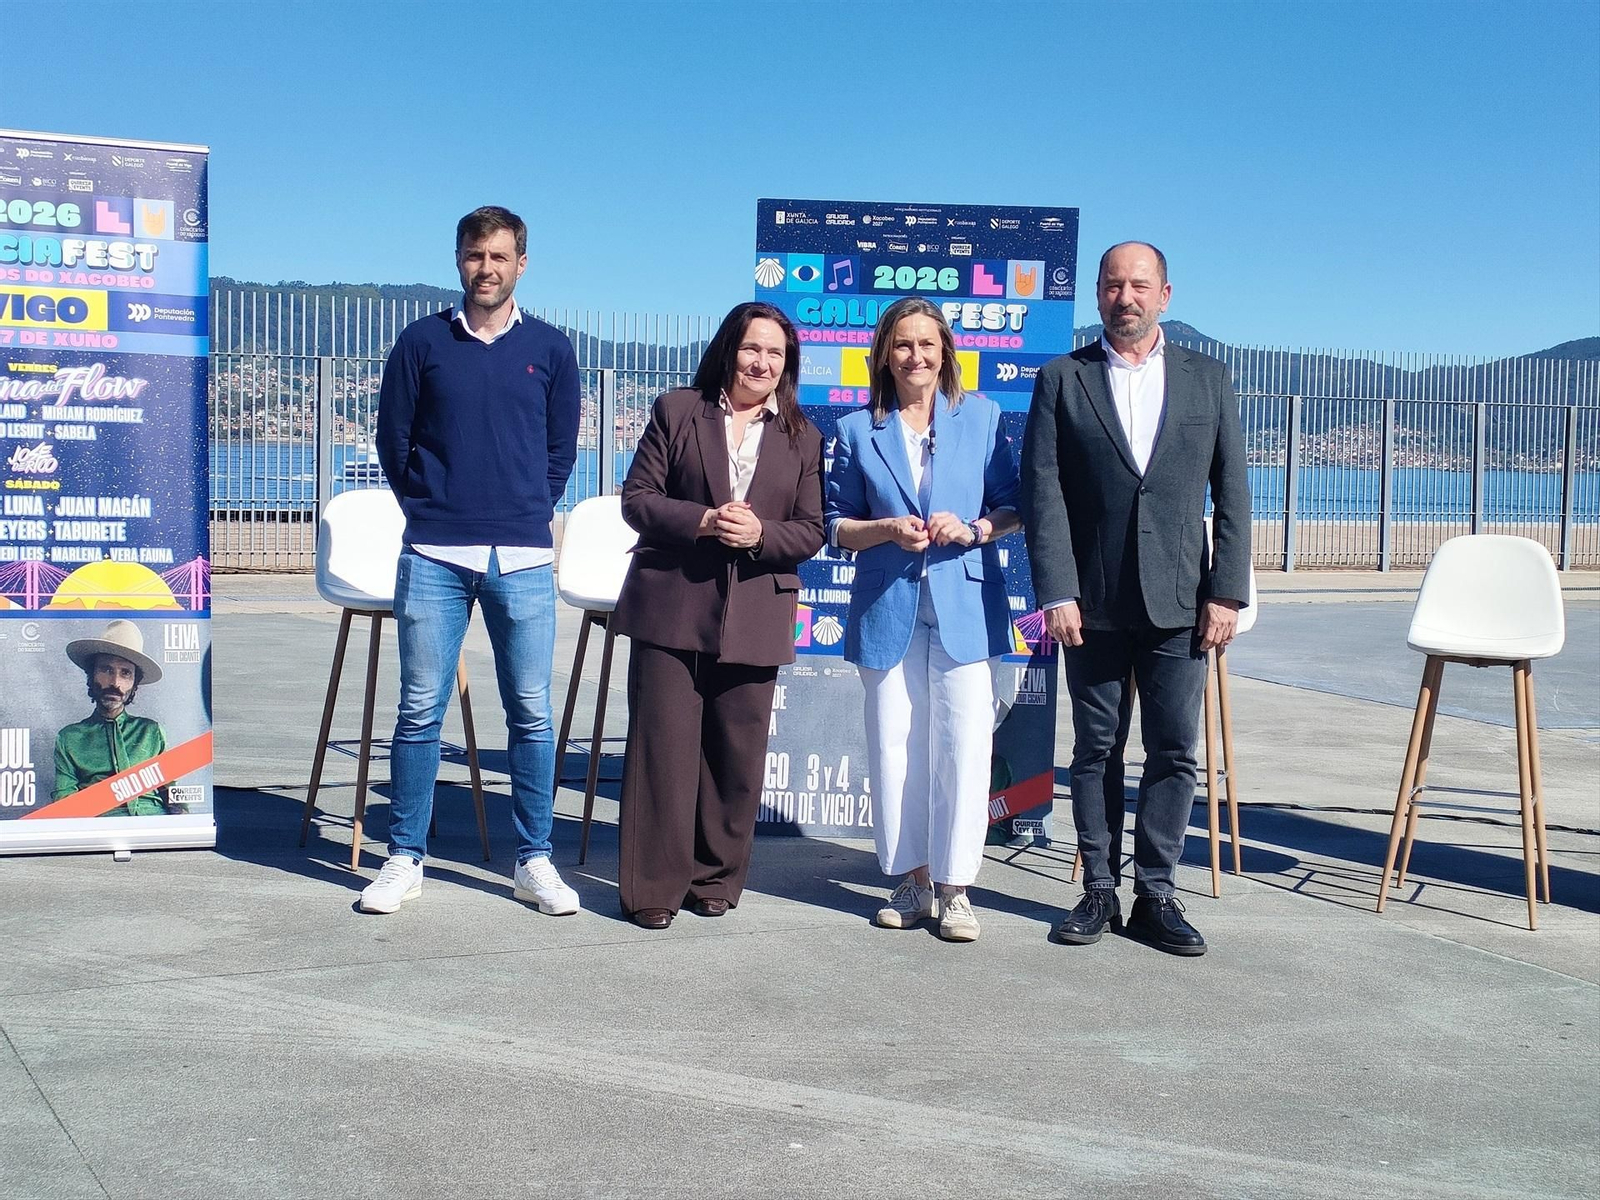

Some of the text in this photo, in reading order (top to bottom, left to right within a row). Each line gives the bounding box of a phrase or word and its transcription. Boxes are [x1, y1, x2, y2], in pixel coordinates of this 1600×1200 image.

[25, 270, 54, 283] DO
[58, 272, 156, 288] XACOBEO
[874, 265, 960, 291] 2026
[154, 307, 194, 316] Deputación
[20, 330, 48, 346] DE
[53, 330, 119, 348] XUÑO
[54, 362, 148, 407] Flow
[828, 388, 868, 403] 26 E
[42, 404, 84, 421] MIRIAM
[86, 405, 144, 424] RODRÍGUEZ
[8, 422, 46, 439] LESUIT
[54, 424, 96, 440] SABELA
[5, 478, 60, 490] SÁBADO
[4, 495, 44, 516] LUNA
[55, 496, 96, 518] JUAN
[98, 494, 152, 518] MAGÁN
[52, 520, 127, 542] TABURETE
[20, 546, 44, 562] LEIS
[51, 547, 103, 562] MARLENA
[110, 547, 139, 563] VERA
[140, 547, 174, 564] FAUNA
[164, 623, 200, 650] LEIVA
[165, 652, 179, 662] TOUR
[1014, 668, 1046, 692] LEIVA
[110, 762, 165, 802] SOLD OUT
[806, 754, 820, 791] 3
[836, 755, 850, 792] 4
[798, 792, 816, 824] DE
[821, 793, 854, 826] VIGO
